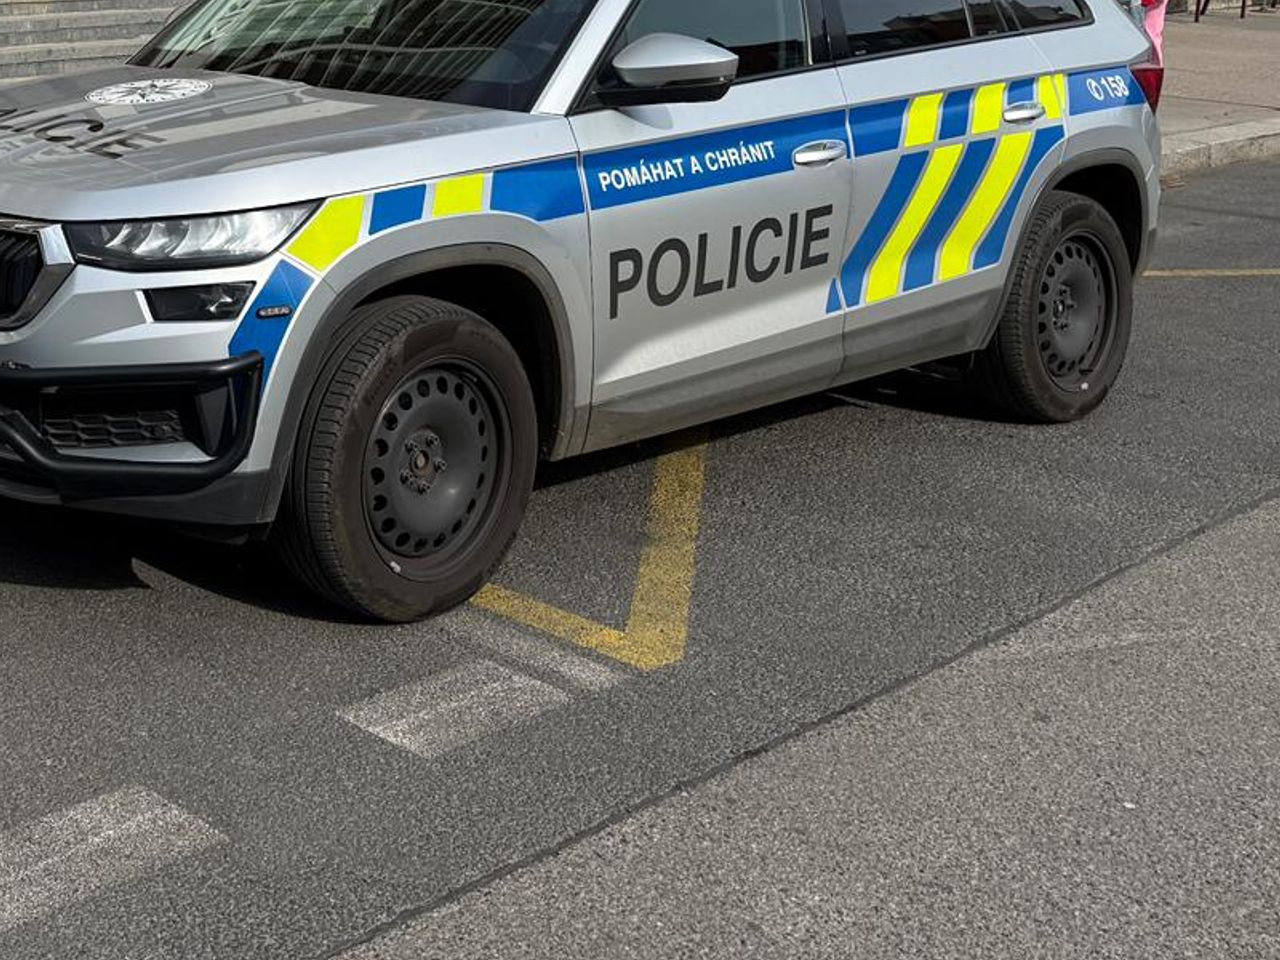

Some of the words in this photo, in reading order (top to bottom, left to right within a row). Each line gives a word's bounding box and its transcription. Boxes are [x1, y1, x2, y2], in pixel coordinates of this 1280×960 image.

[1100, 75, 1129, 99] 158
[598, 157, 685, 192] POMÁHAT
[690, 158, 704, 174] A
[705, 140, 776, 171] CHRÁNIT
[609, 204, 833, 320] POLICIE
